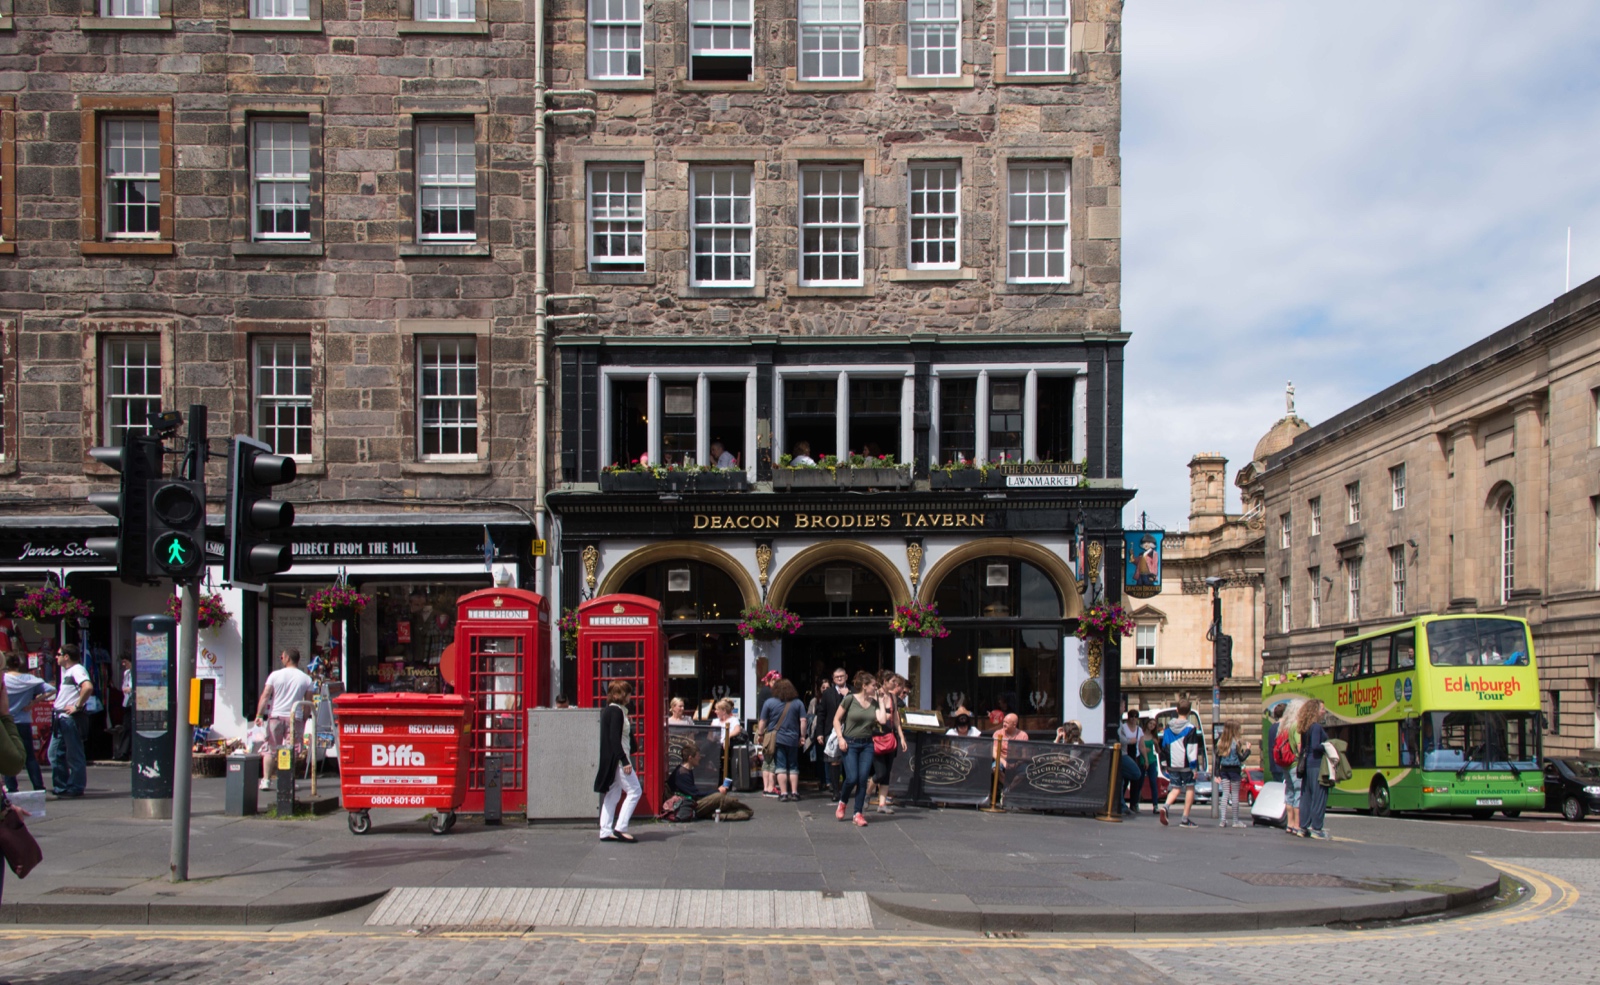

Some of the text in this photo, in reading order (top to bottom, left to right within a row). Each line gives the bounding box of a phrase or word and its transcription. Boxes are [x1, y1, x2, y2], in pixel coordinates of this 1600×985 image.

[1003, 464, 1081, 474] THE ROYAL MILE
[1008, 477, 1076, 486] LAWNMARKET
[693, 512, 985, 529] DEACON BRODIE'S TAVERN
[18, 543, 61, 560] Jamie
[291, 542, 418, 555] DIRECT FROM THE MILL
[534, 541, 544, 553] H
[470, 610, 527, 619] TELEPHONE
[592, 617, 647, 625] TELEPHONE
[405, 666, 437, 676] Tweed
[1444, 675, 1521, 696] Edinburgh
[1338, 679, 1382, 708] Edinburgh
[1476, 691, 1504, 700] Tour
[1355, 703, 1372, 716] Tour
[343, 724, 455, 734] DRY MIXED RECYCLABLES
[371, 744, 425, 766] Biffa
[920, 757, 965, 772] ICHOLSON'S
[1032, 766, 1081, 780] NICHOLSON'S
